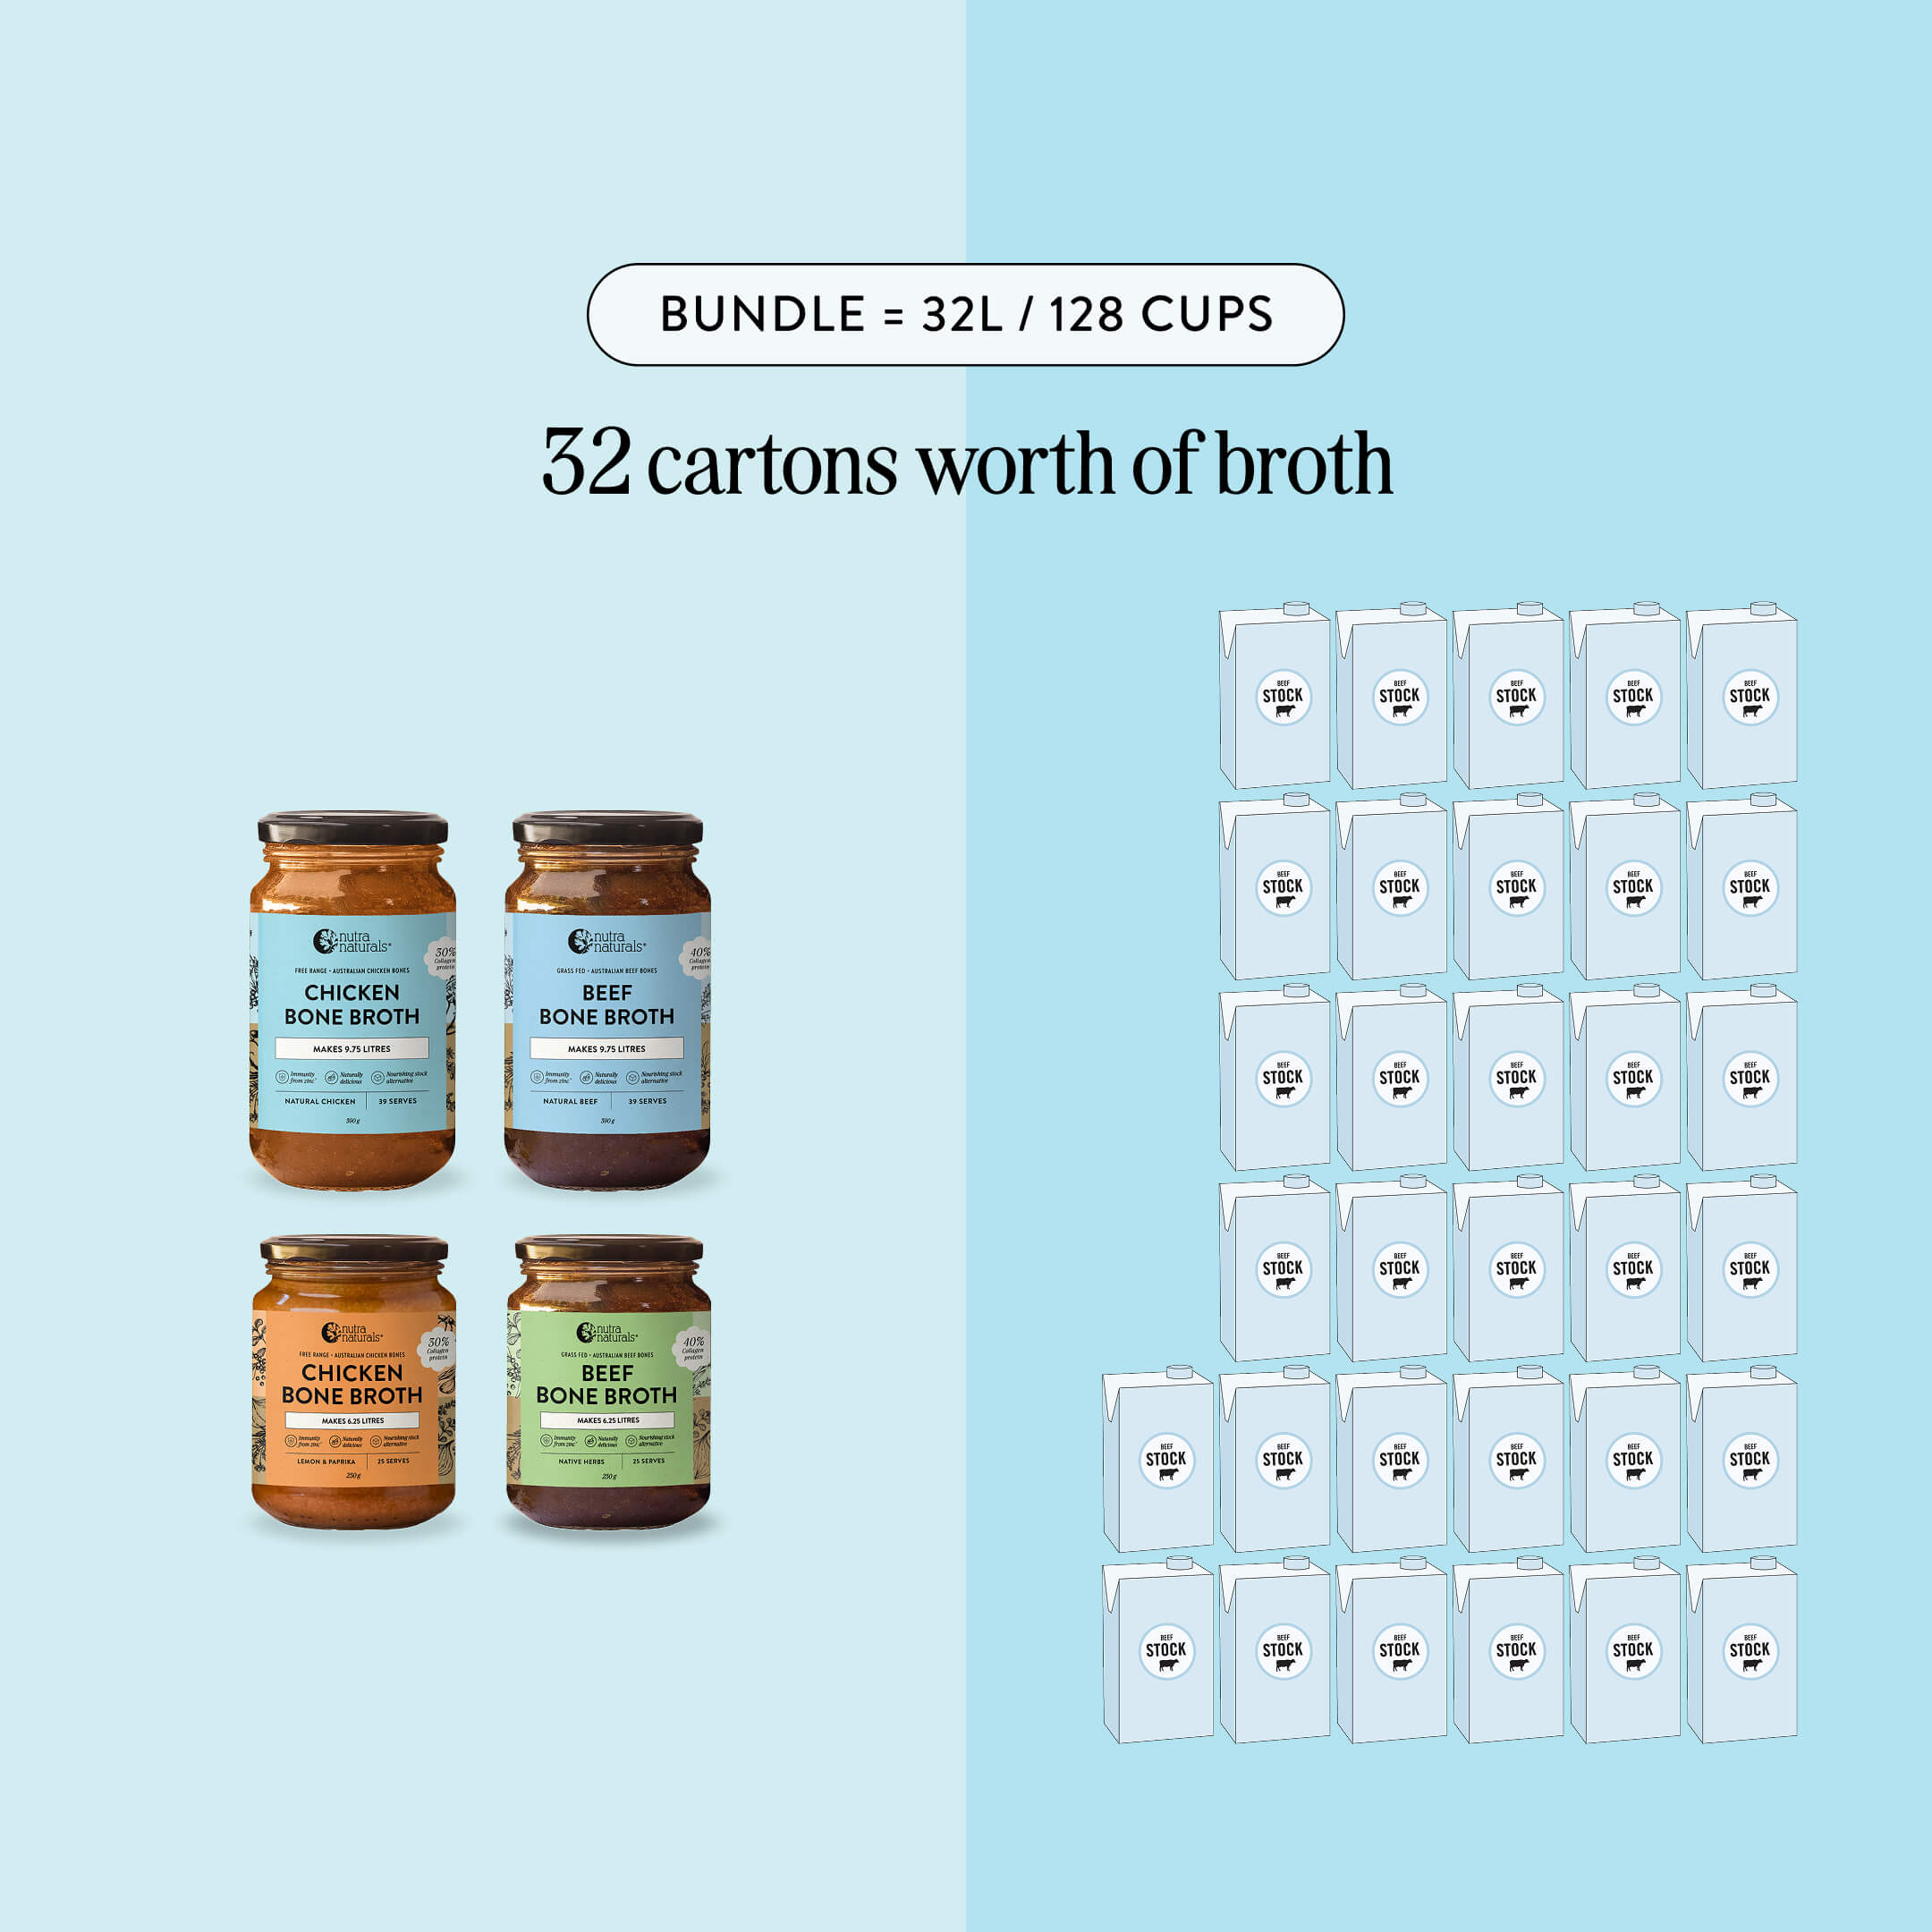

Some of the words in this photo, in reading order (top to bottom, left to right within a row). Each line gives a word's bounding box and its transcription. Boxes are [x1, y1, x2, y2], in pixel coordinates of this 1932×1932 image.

[1263, 688, 1303, 702] STOCK
[1380, 688, 1419, 702] STOCK
[1614, 688, 1653, 702] STOCK
[1730, 688, 1770, 702] STOCK
[1380, 878, 1419, 894] STOCK
[1496, 878, 1537, 894] STOCK
[1614, 878, 1653, 894] STOCK
[1730, 878, 1770, 894] STOCK
[339, 930, 369, 942] nutra
[594, 930, 624, 942] nutra
[436, 948, 456, 957] 30%
[690, 948, 710, 957] 40%
[305, 985, 399, 1001] CHICKEN
[583, 985, 632, 1001] BEEF
[285, 1009, 343, 1025] BONE
[351, 1009, 419, 1024] BROTH
[540, 1009, 597, 1025] BONE
[605, 1009, 674, 1024] BROTH
[1263, 1070, 1303, 1084] STOCK
[1380, 1070, 1419, 1084] STOCK
[1496, 1070, 1537, 1084] STOCK
[1730, 1070, 1770, 1084] STOCK
[1263, 1260, 1303, 1275] STOCK
[1496, 1260, 1537, 1275] STOCK
[1614, 1260, 1653, 1275] STOCK
[1730, 1260, 1770, 1275] STOCK
[342, 1325, 366, 1334] nutra
[597, 1325, 621, 1334] nutra
[428, 1337, 450, 1347] 30%
[683, 1336, 705, 1346] 40%
[682, 1347, 704, 1355] Collagen
[302, 1364, 402, 1382] CHICKEN
[582, 1365, 633, 1381] BEEF
[283, 1386, 343, 1404] BONE
[351, 1386, 422, 1404] BROTH
[538, 1386, 597, 1404] BONE
[606, 1386, 677, 1404] BROTH
[1147, 1452, 1186, 1466] STOCK
[1263, 1452, 1303, 1466] STOCK
[1380, 1452, 1419, 1466] STOCK
[1614, 1452, 1653, 1466] STOCK
[1730, 1452, 1770, 1466] STOCK
[1147, 1642, 1186, 1657] STOCK
[1380, 1642, 1419, 1657] STOCK
[1496, 1642, 1537, 1657] STOCK
[1614, 1642, 1653, 1657] STOCK
[1730, 1642, 1770, 1657] STOCK
